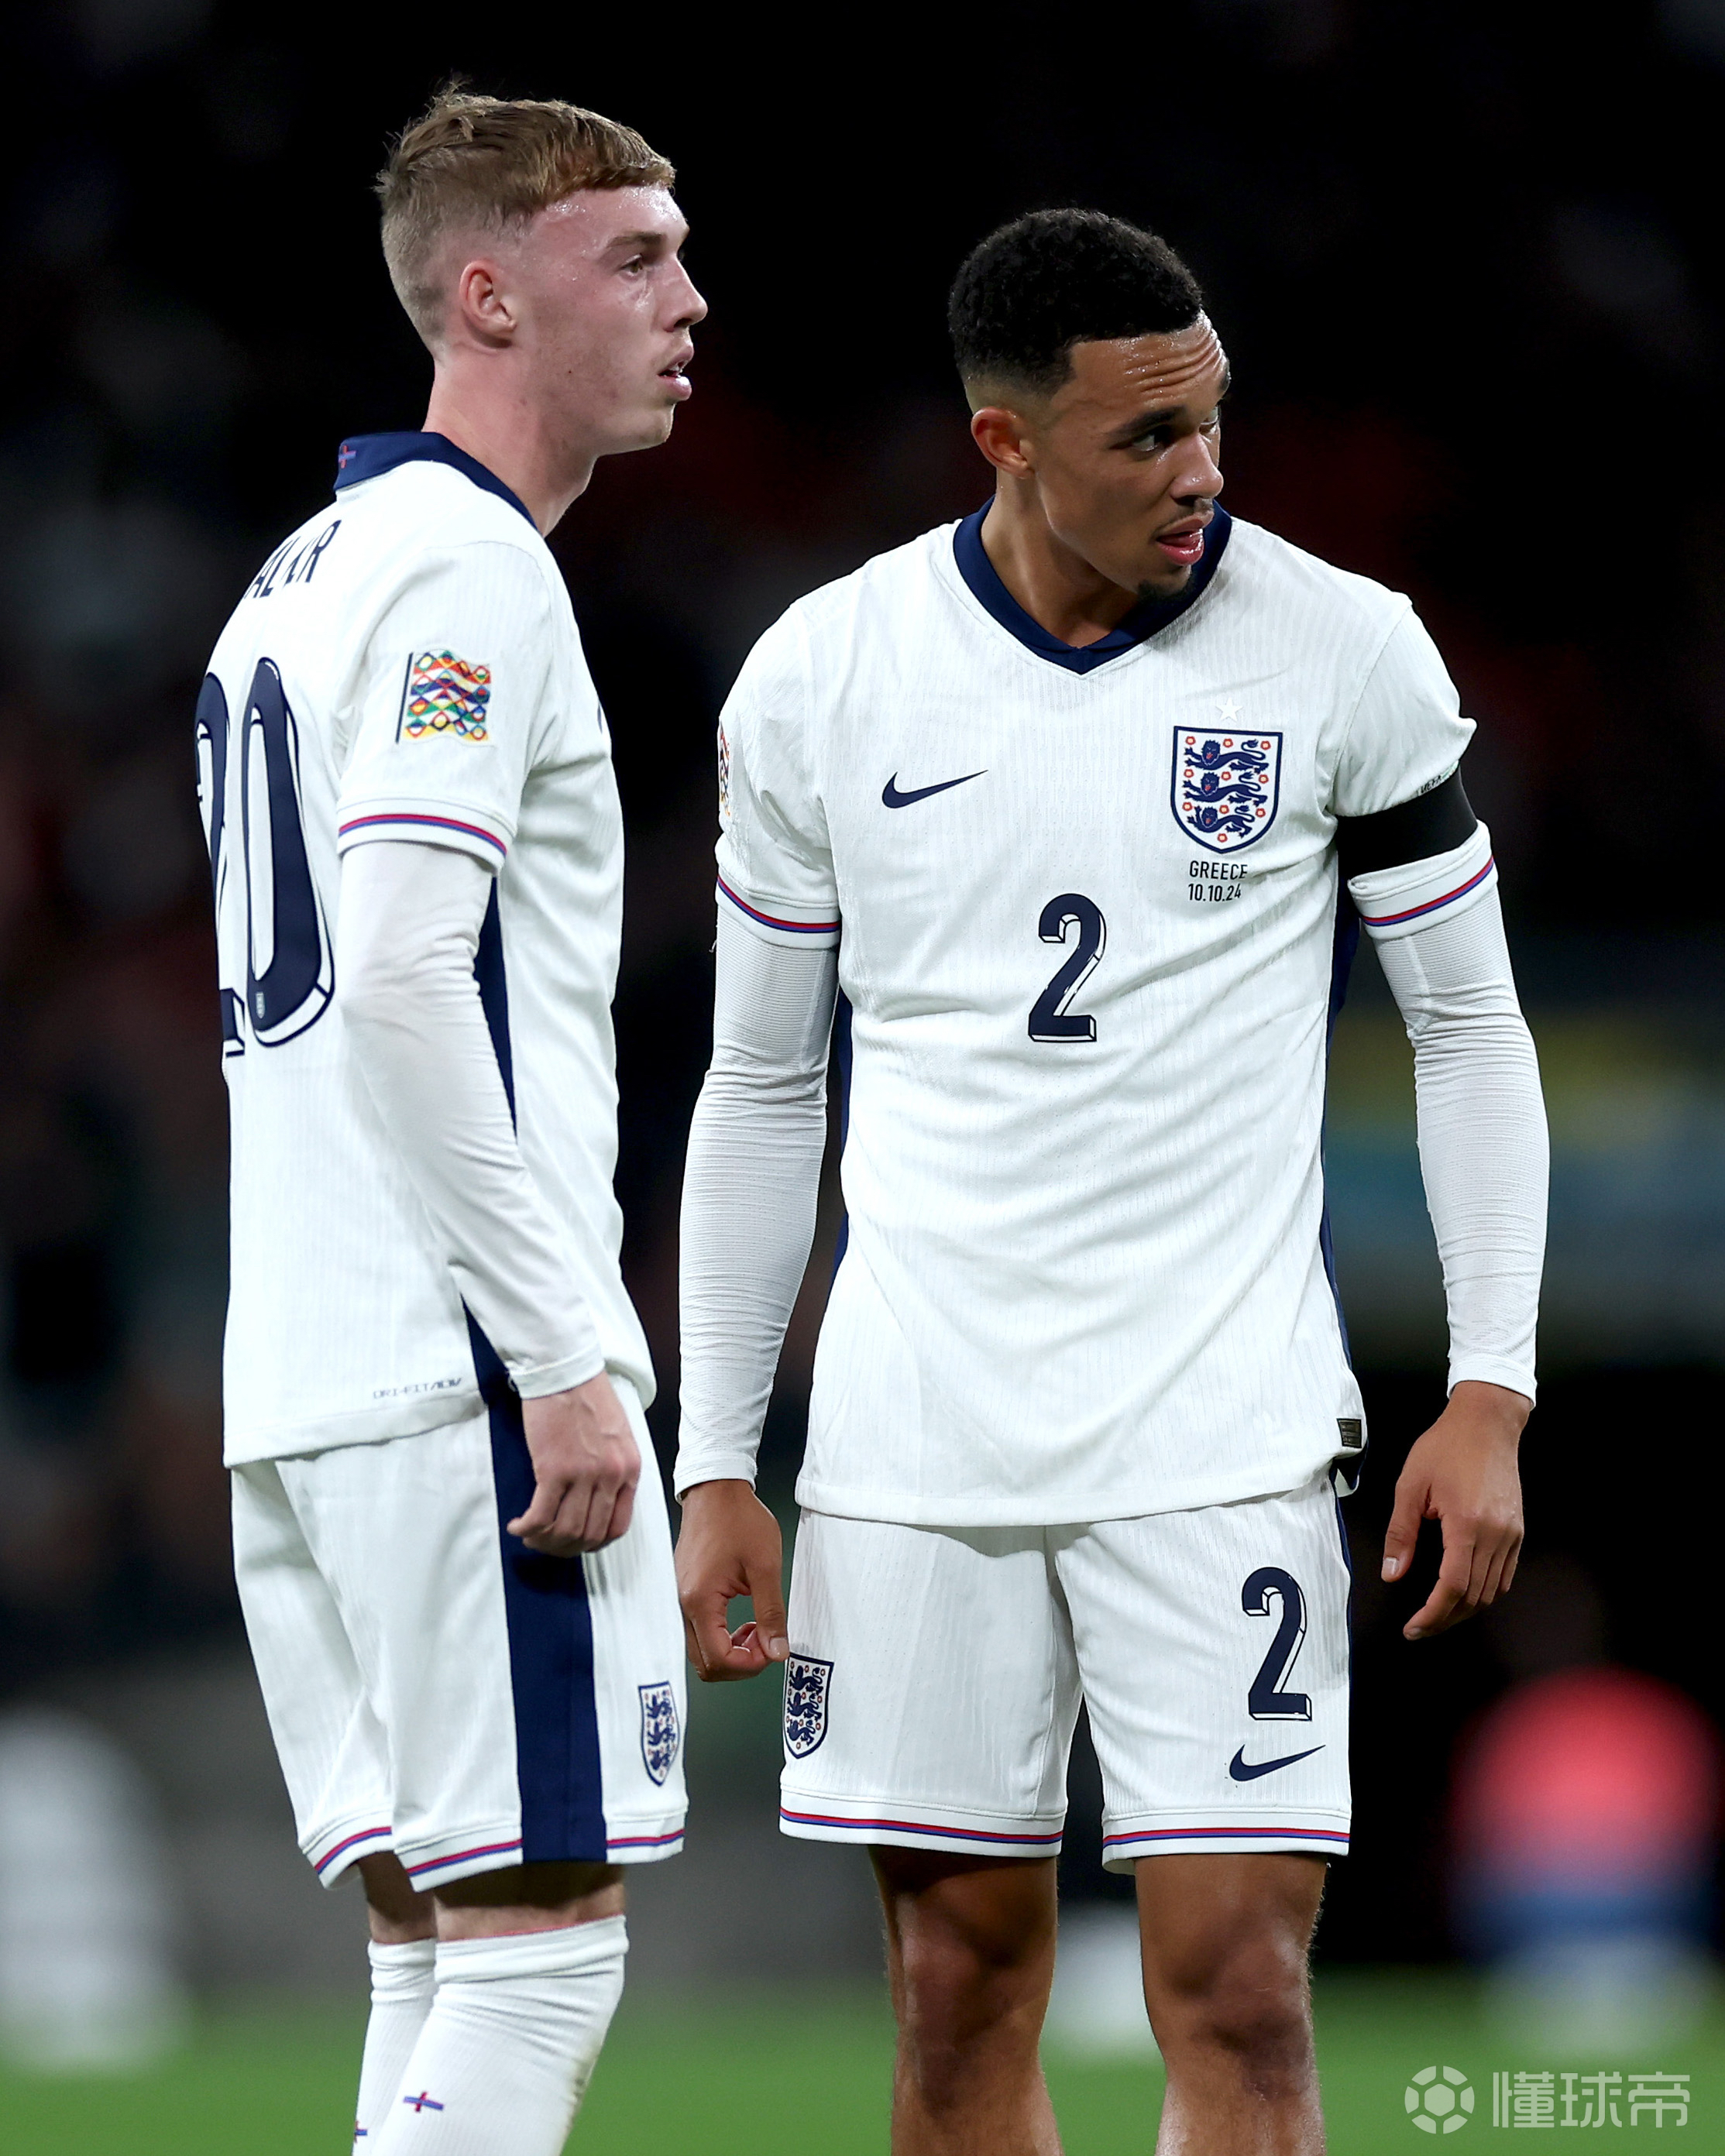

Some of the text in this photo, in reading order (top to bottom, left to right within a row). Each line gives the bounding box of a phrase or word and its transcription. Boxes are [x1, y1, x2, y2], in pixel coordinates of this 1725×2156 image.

[194, 656, 335, 1057] 20
[1187, 883, 1242, 902] 10.10.24
[1189, 860, 1248, 880] GREECE
[1028, 893, 1107, 1042] 2
[1242, 1566, 1312, 1722] 2
